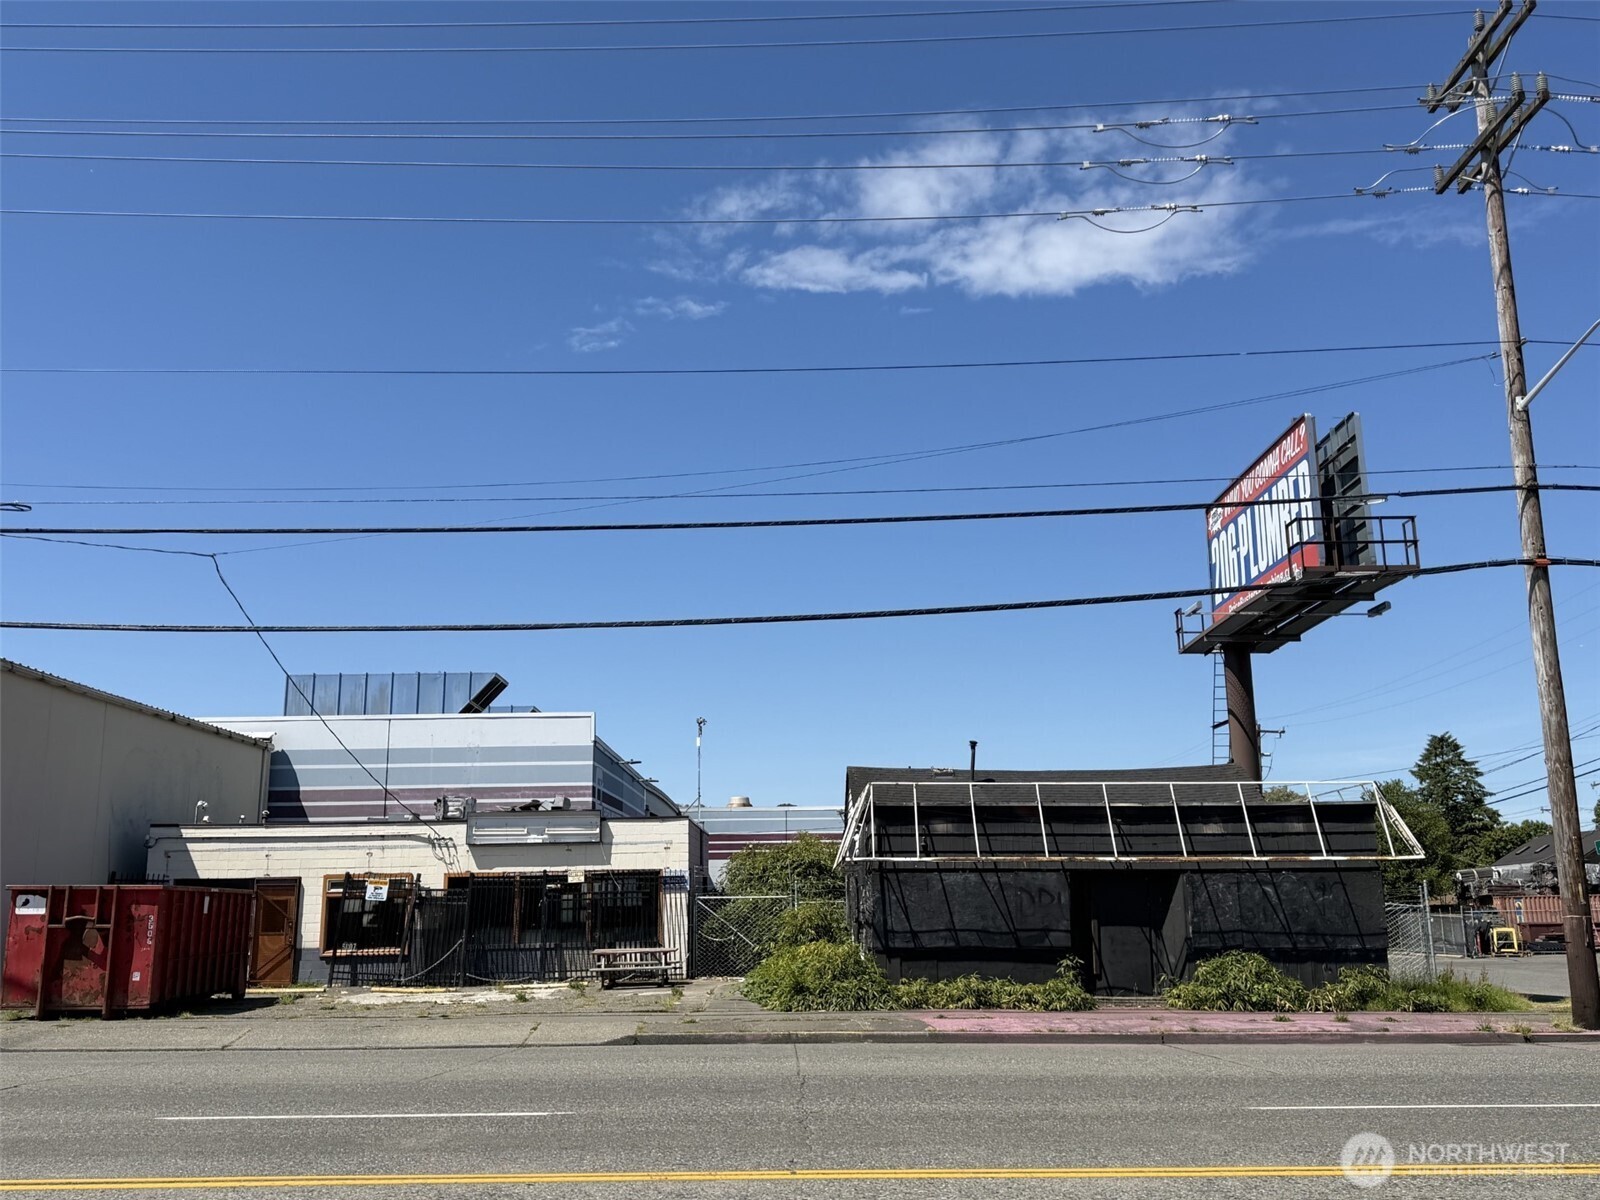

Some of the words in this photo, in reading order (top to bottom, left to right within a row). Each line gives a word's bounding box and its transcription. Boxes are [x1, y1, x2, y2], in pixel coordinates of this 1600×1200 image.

[1240, 470, 1255, 503] YOU
[1254, 446, 1280, 489] GONNA
[1281, 422, 1306, 465] CALL?
[1211, 459, 1315, 606] 206-PLUMBER
